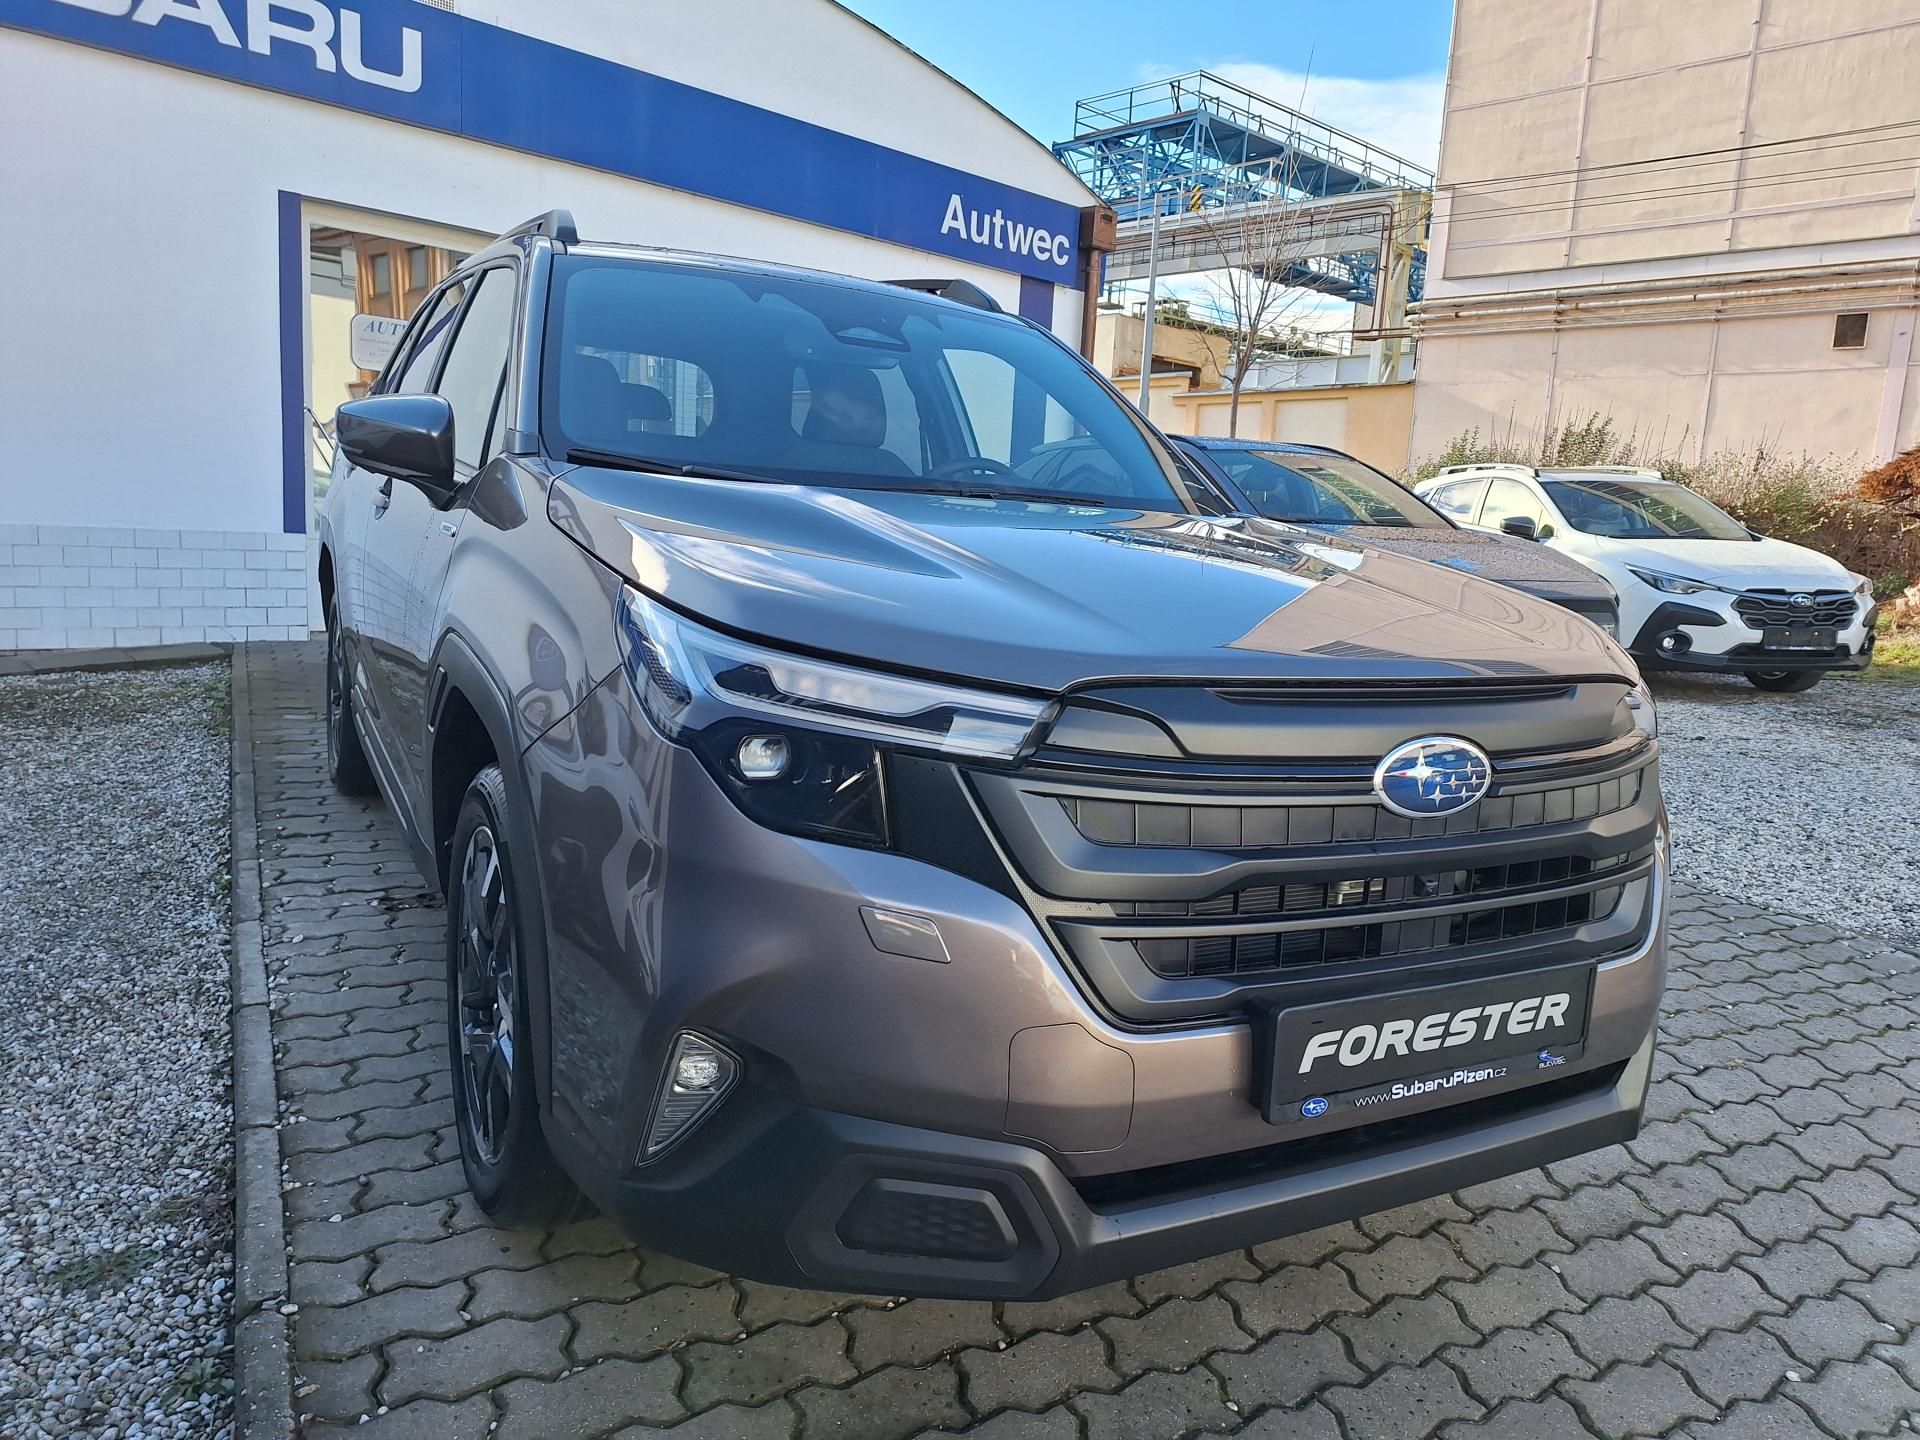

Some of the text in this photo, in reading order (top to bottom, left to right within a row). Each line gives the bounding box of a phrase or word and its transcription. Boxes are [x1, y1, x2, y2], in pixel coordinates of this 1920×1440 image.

[50, 0, 423, 93] ARU
[940, 193, 1070, 266] Autwec
[363, 319, 407, 336] AUT
[1298, 992, 1571, 1075] FORESTER
[1354, 1067, 1507, 1107] www.SubaruPlzen.cz
